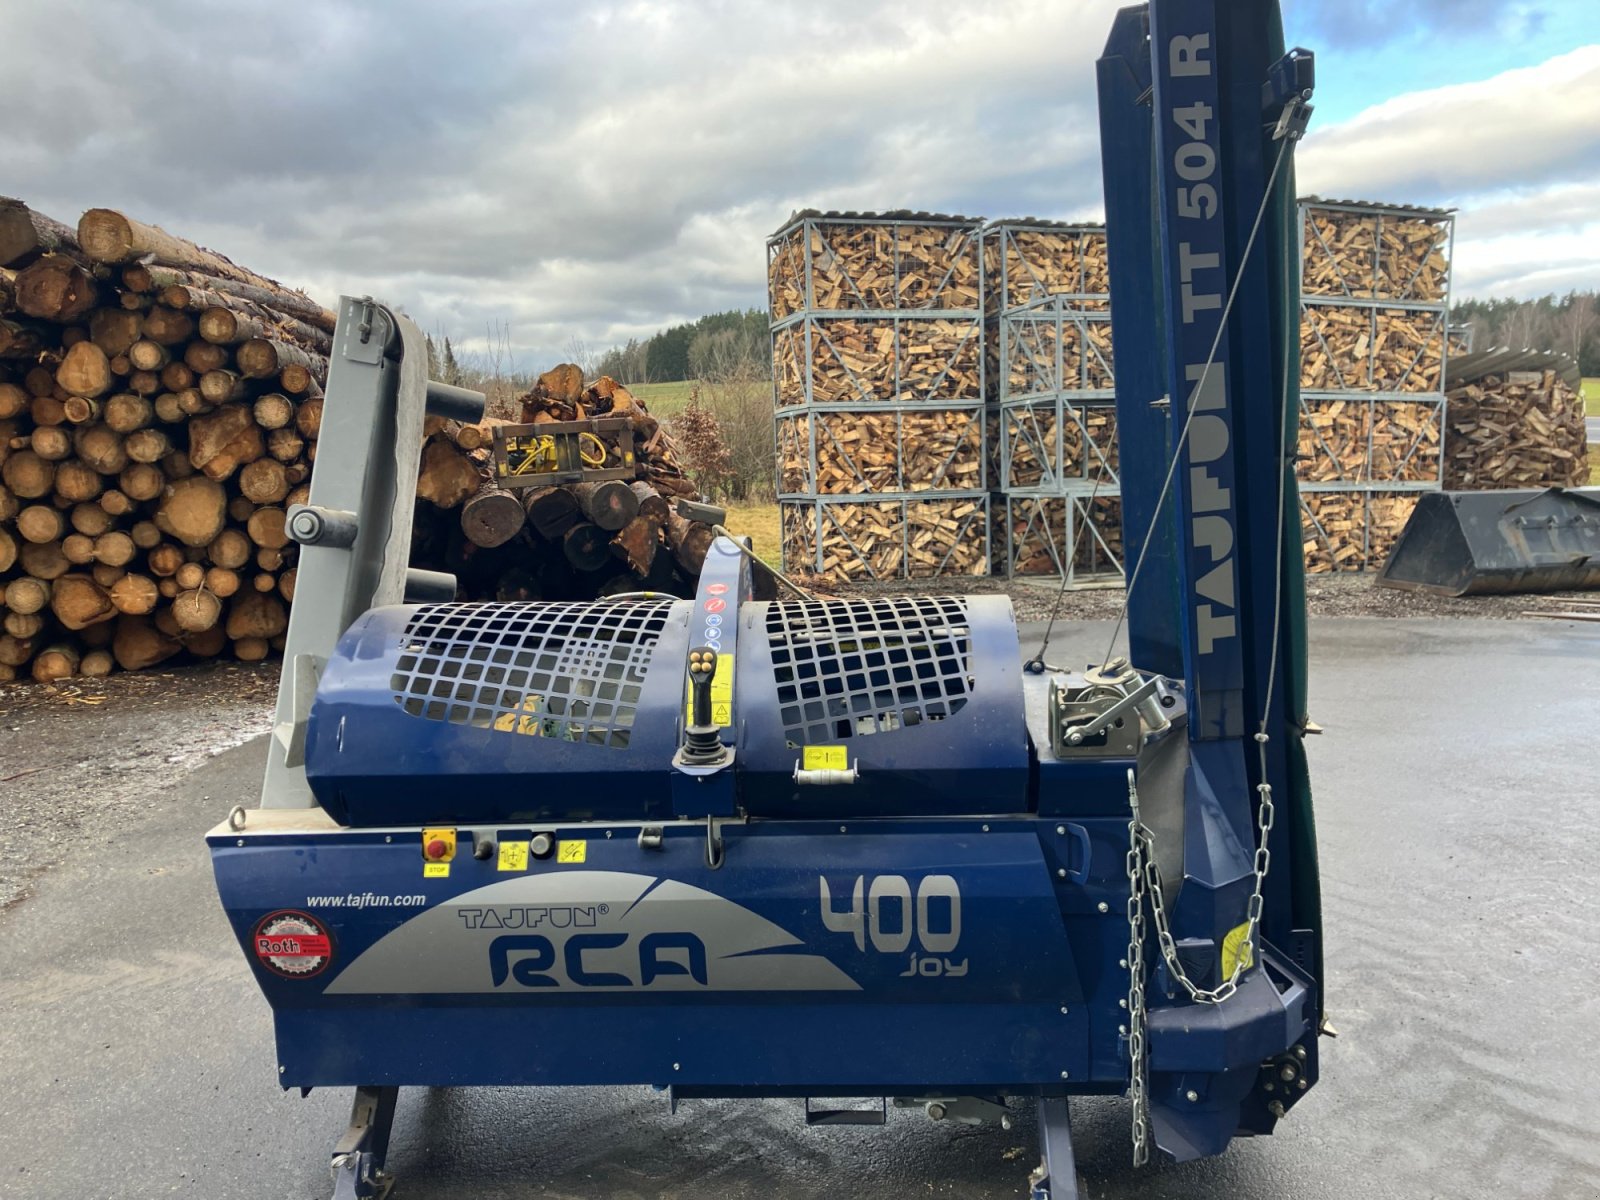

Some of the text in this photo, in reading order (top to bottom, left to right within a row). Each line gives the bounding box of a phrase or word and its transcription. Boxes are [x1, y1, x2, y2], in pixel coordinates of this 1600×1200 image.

[1169, 32, 1236, 655] TAJFUN TT 504 R
[306, 892, 426, 910] www.tajfun.com
[820, 875, 961, 953] 400
[258, 938, 301, 954] Roth
[489, 931, 708, 988] RCA
